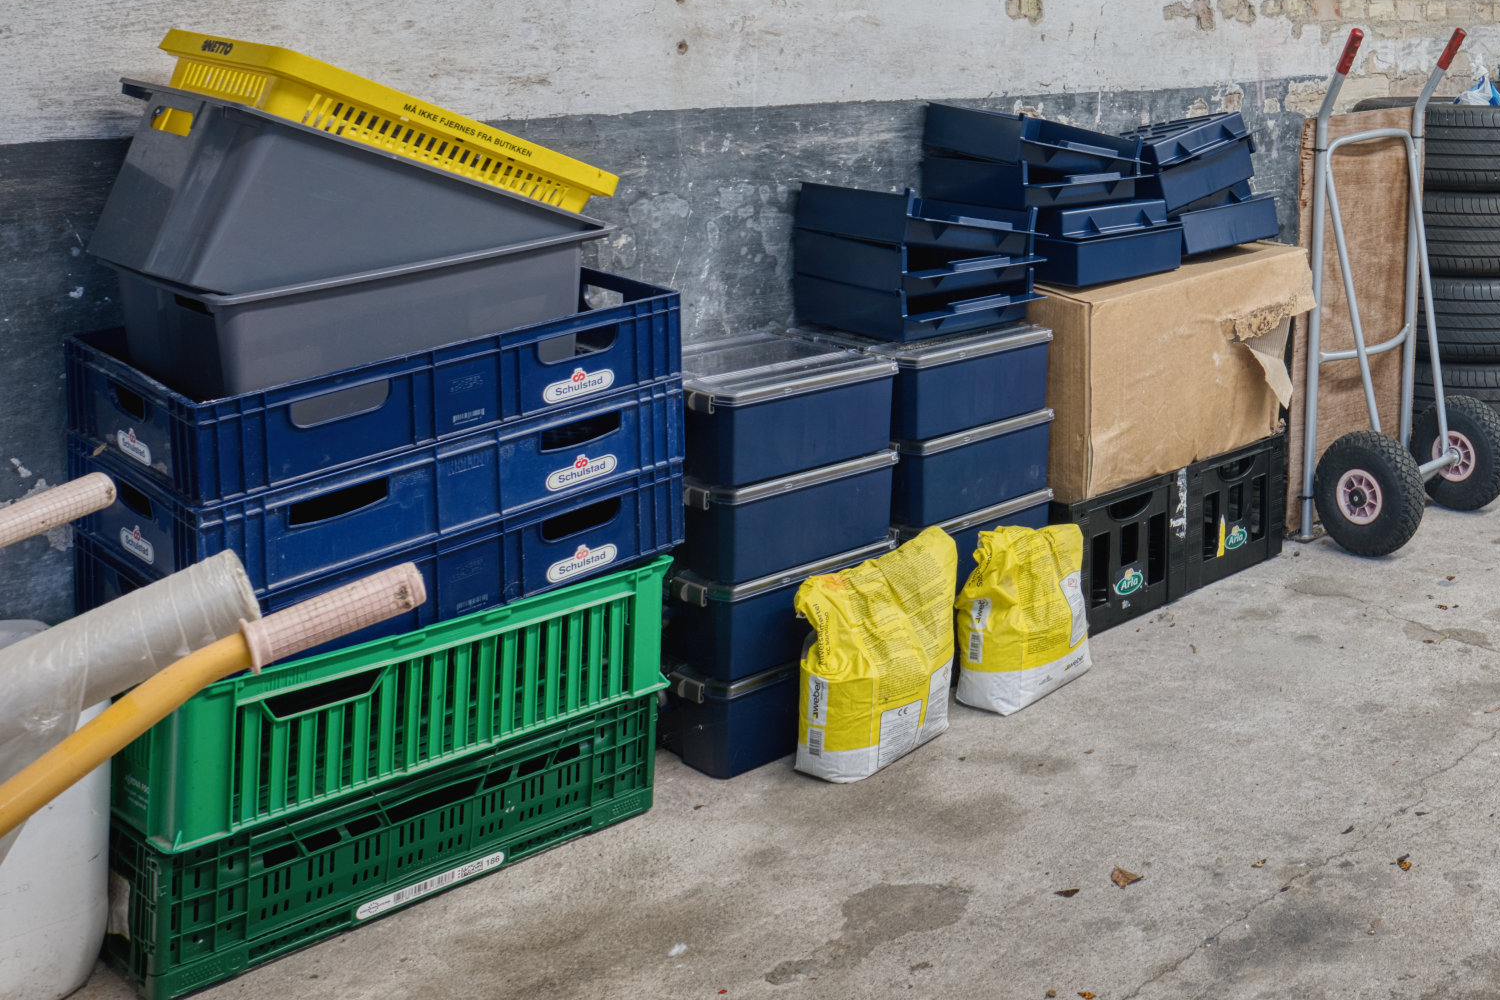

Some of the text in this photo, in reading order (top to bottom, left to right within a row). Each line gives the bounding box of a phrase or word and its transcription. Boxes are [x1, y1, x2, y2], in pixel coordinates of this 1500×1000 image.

[205, 39, 234, 56] NETTO
[403, 103, 533, 158] MÅ IKKE FJERNES FRA BUTIKKEN
[555, 376, 603, 396] Schulstad
[558, 461, 606, 484] Schulstad
[1228, 533, 1243, 545] Arla
[558, 551, 606, 575] Schulstad
[1120, 577, 1138, 591] Arla
[812, 680, 820, 712] weber
[486, 855, 500, 867] 186
